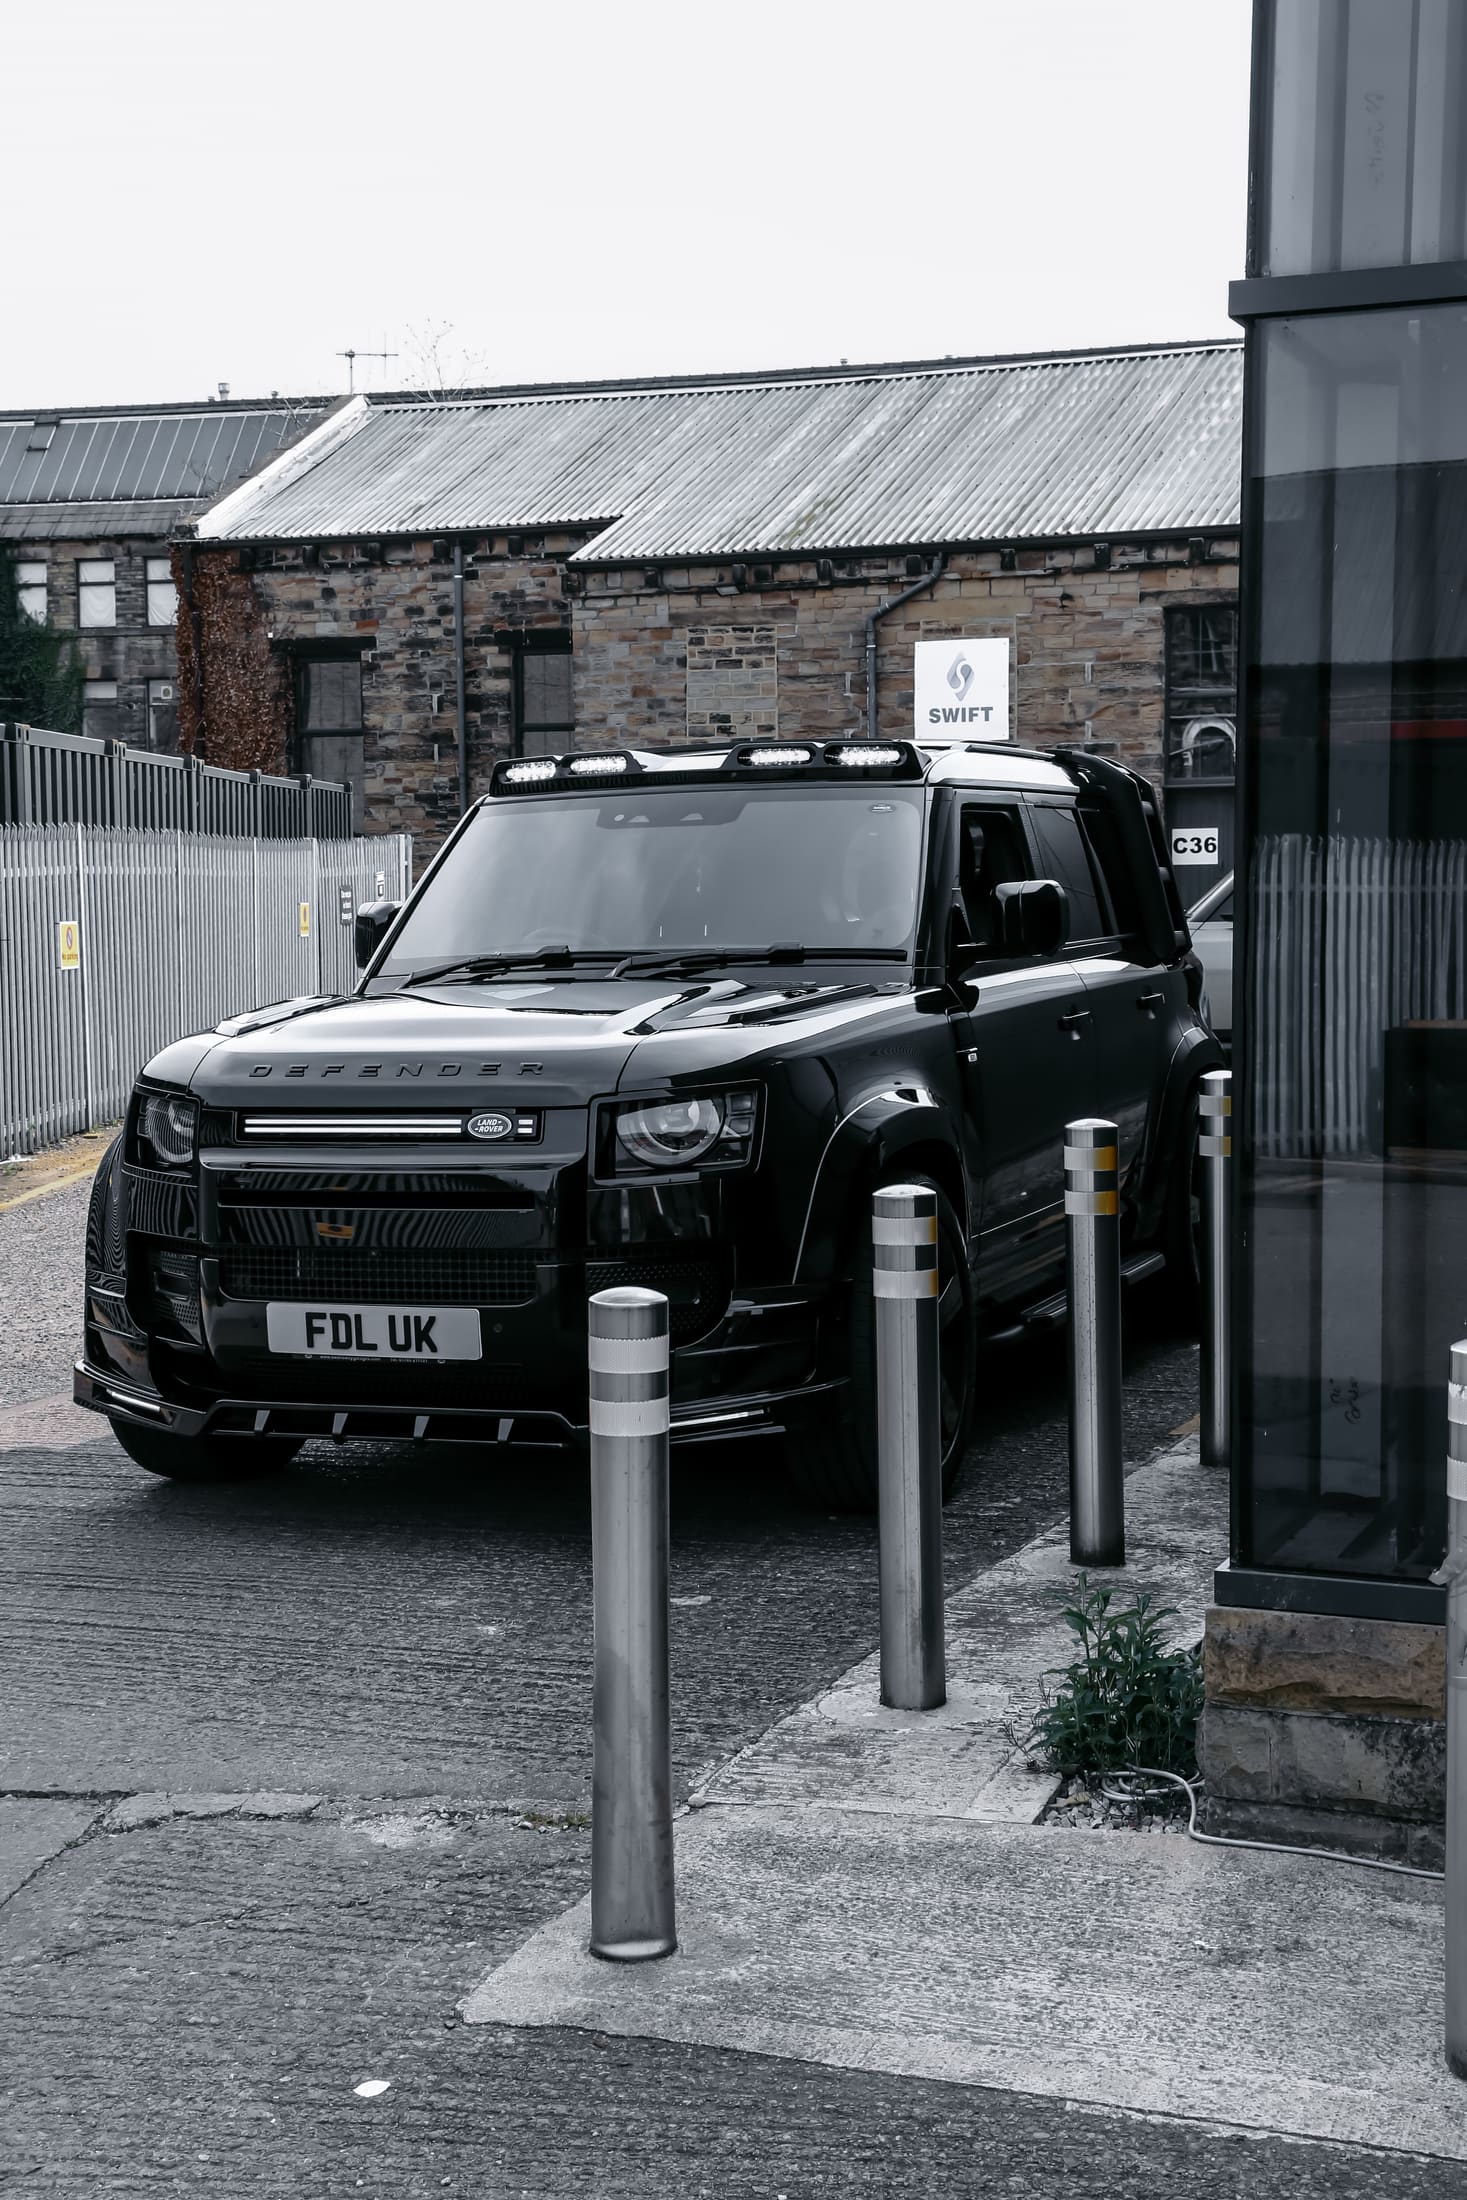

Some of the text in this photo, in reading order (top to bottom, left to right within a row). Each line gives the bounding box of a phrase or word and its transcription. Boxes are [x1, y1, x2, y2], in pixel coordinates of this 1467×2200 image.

[929, 706, 993, 723] SWIFT
[1173, 837, 1217, 854] C36
[249, 1062, 544, 1077] DEFENDER
[305, 1312, 438, 1353] FDL UK
